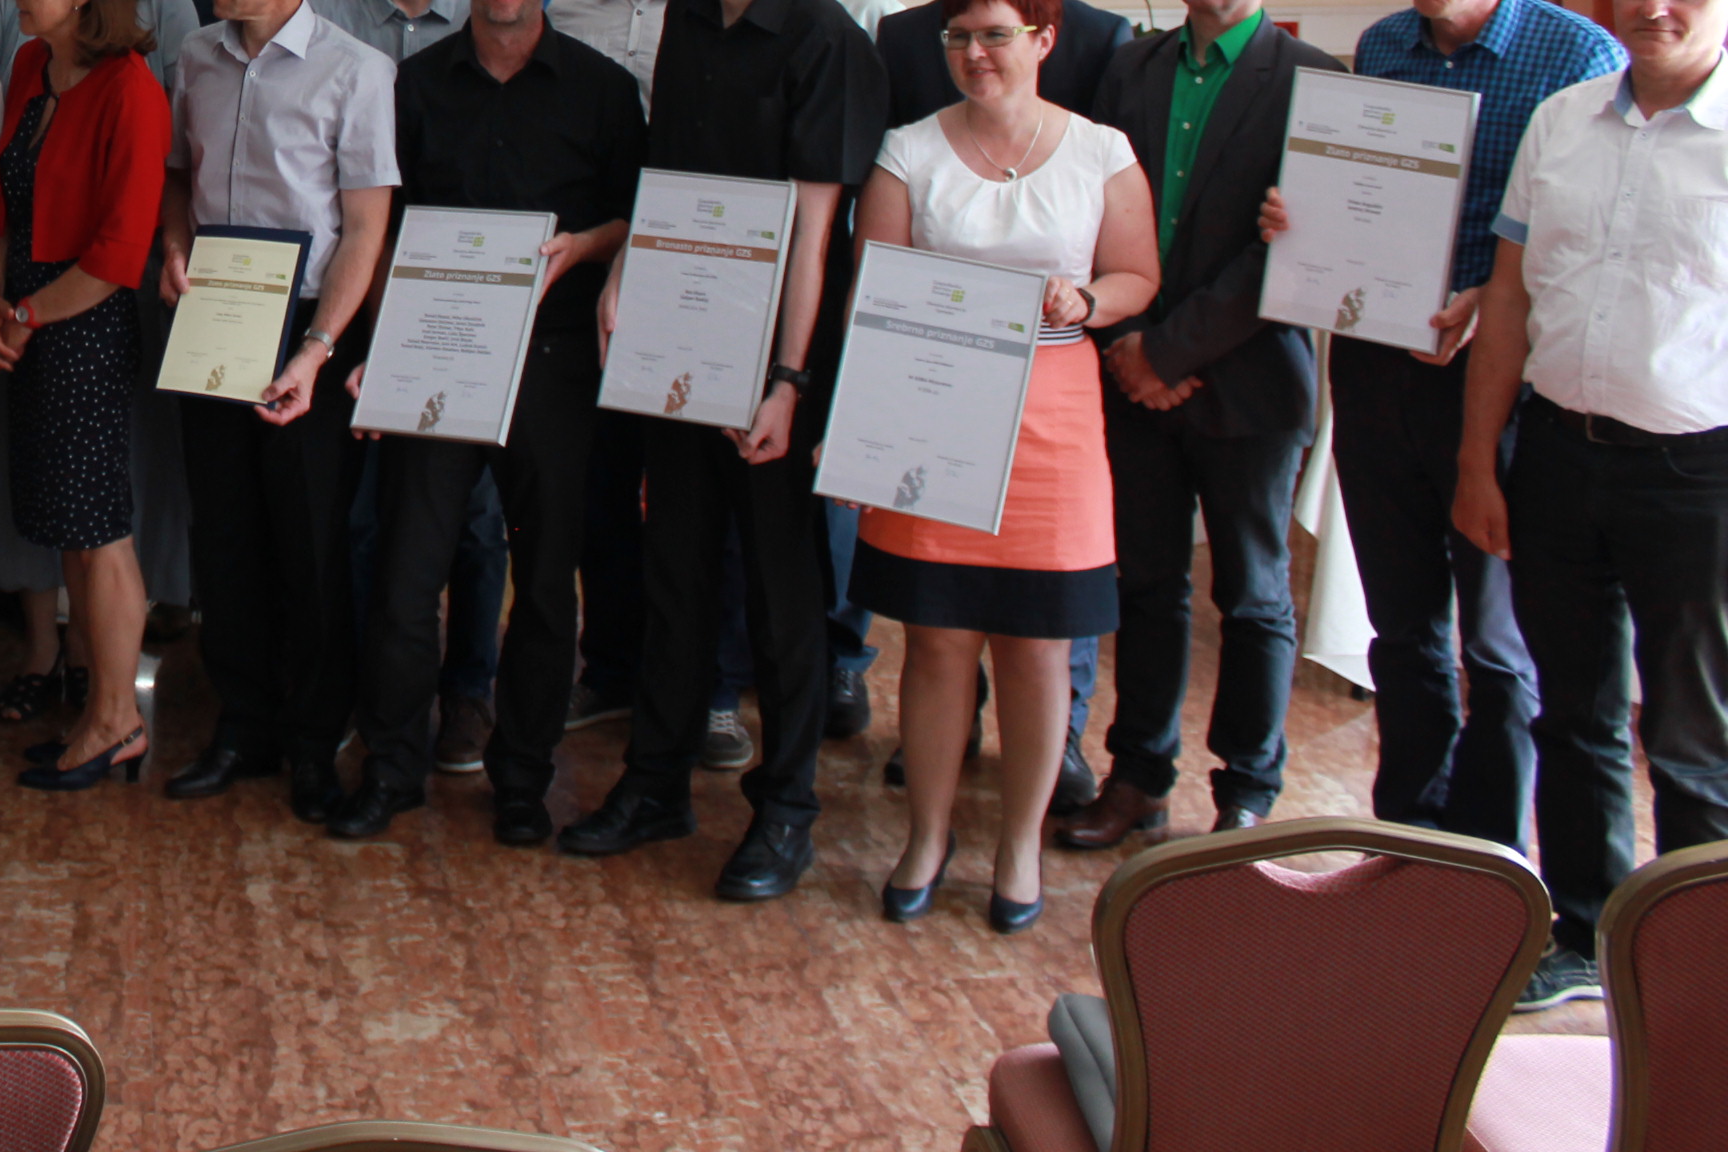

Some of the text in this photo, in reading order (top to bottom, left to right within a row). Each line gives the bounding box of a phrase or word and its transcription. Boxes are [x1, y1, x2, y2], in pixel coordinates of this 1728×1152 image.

[423, 270, 502, 282] Zlato priznanje GZS
